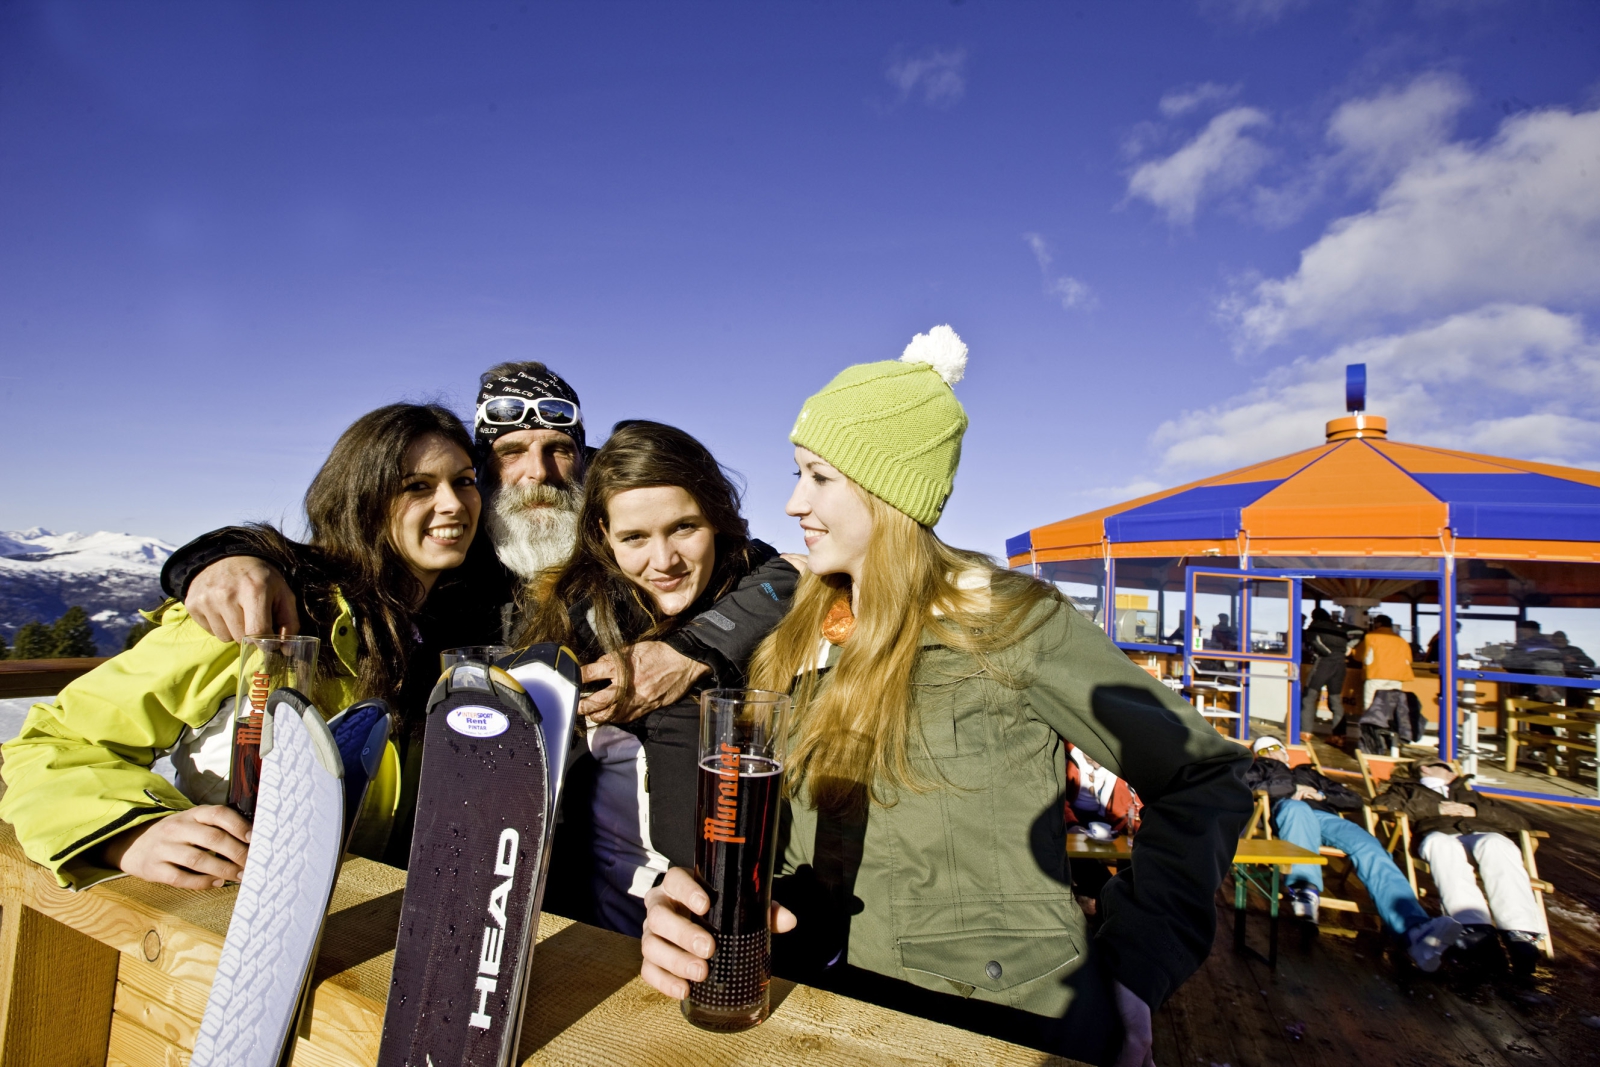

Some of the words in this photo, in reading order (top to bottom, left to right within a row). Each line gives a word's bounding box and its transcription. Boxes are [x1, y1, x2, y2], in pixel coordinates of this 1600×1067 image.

[462, 711, 493, 719] INTERSPORT
[704, 742, 746, 844] Murauer
[469, 827, 520, 1030] HEAD
